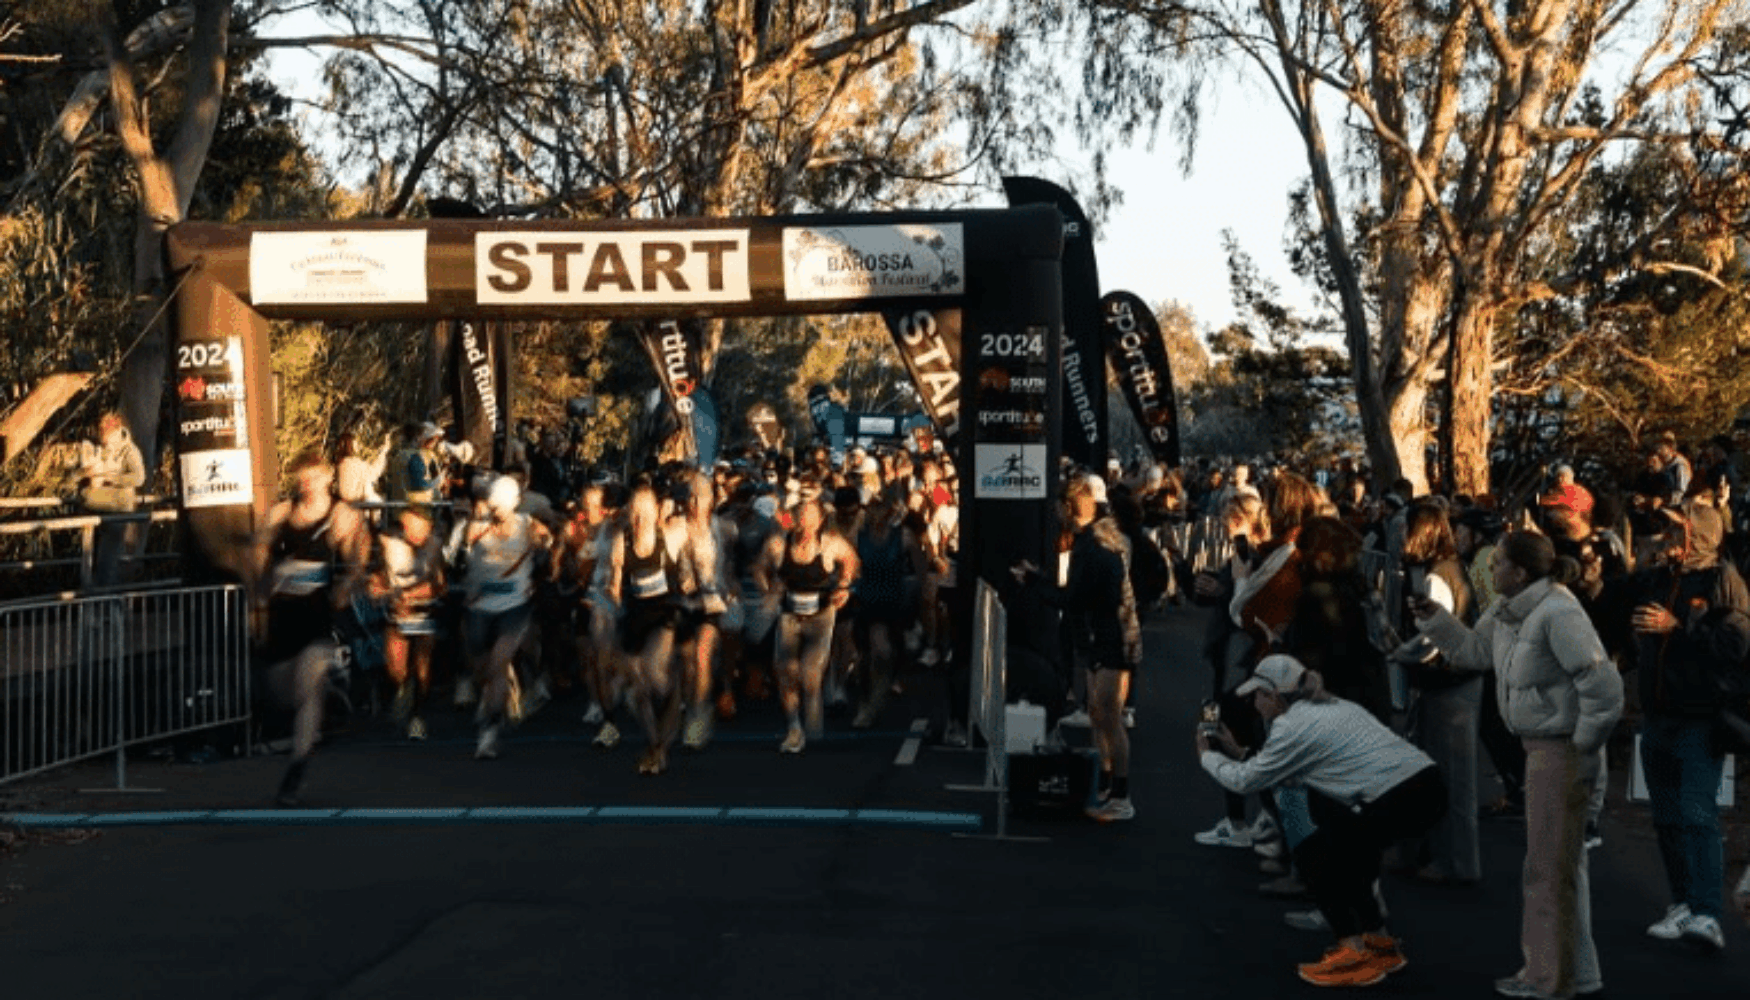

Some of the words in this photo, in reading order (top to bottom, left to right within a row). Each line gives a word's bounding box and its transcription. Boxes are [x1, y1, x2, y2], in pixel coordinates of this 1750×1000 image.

[486, 240, 739, 293] START
[827, 253, 914, 272] BAROSSA
[981, 334, 1044, 356] 2024
[1061, 352, 1098, 444] Runners
